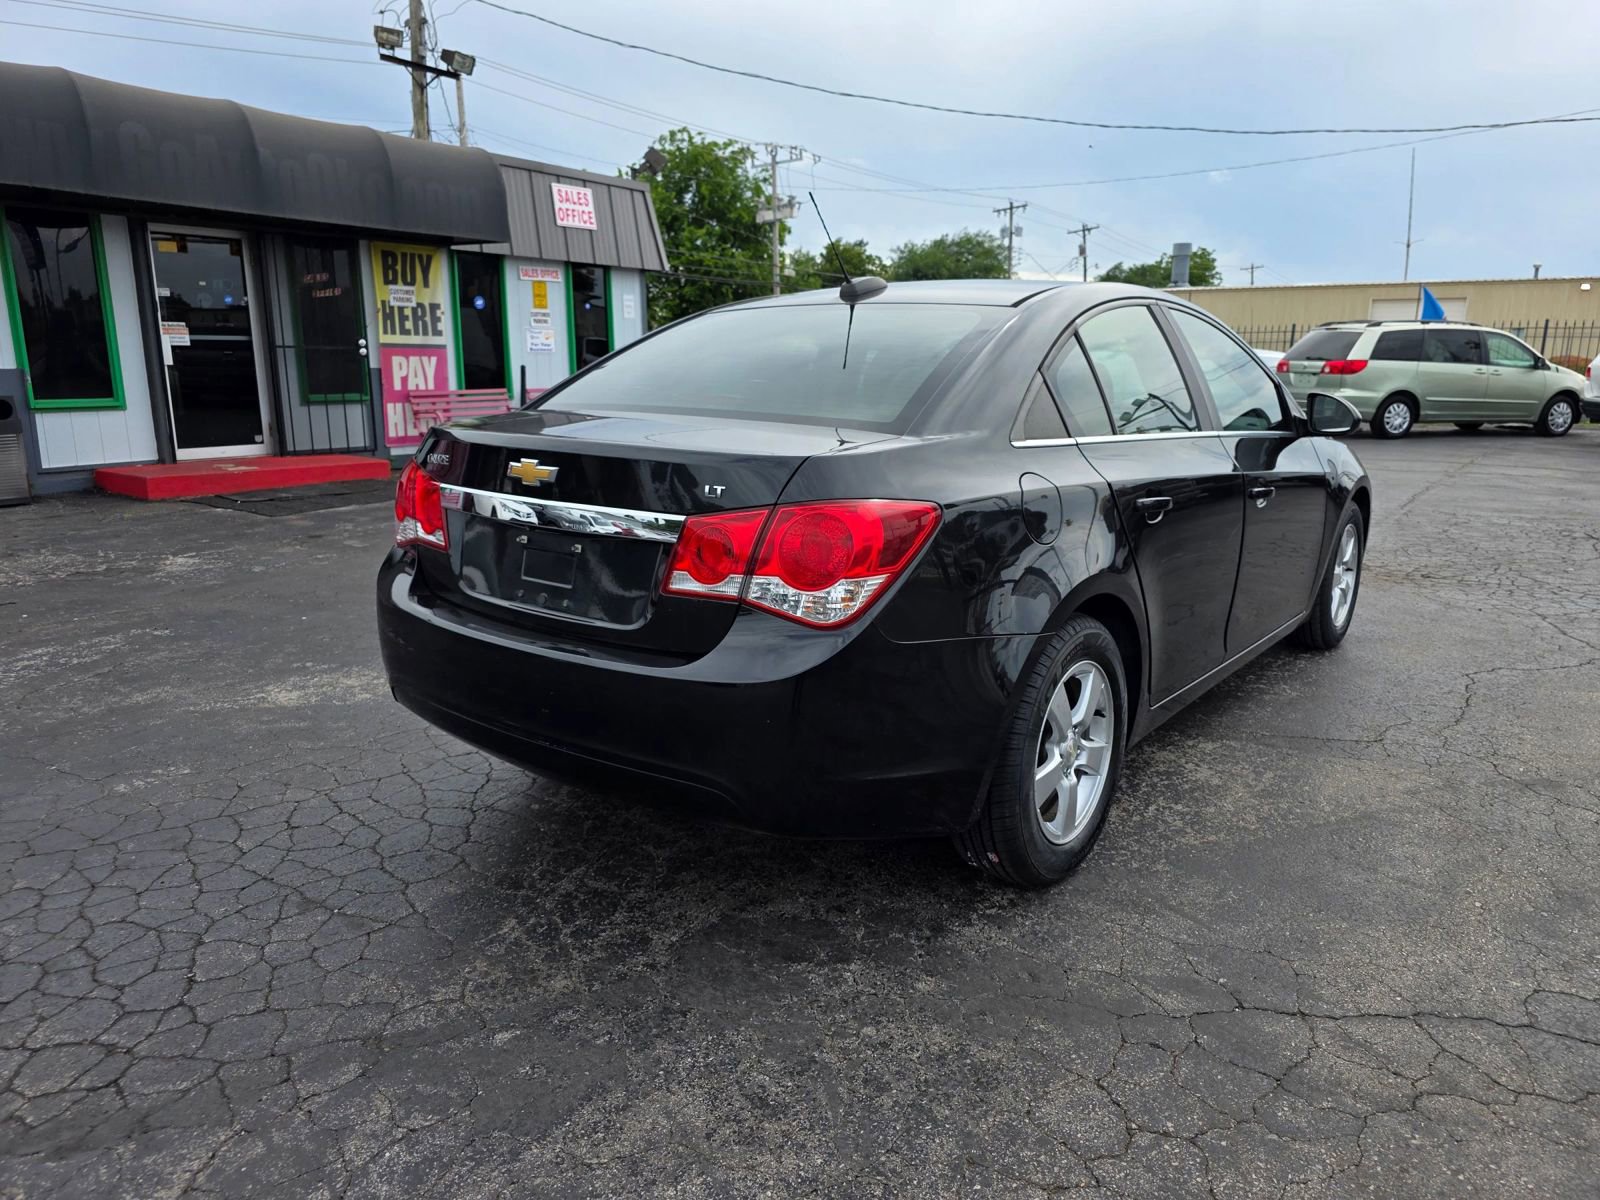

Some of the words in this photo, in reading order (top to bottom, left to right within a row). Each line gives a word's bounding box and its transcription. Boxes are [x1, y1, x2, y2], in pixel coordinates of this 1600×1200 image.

[557, 188, 590, 207] SALES
[558, 207, 595, 225] OFFICE
[381, 249, 433, 289] BUY
[520, 267, 539, 278] SALES
[540, 269, 560, 280] OFFICE
[390, 288, 415, 296] CUSTOMER
[381, 300, 443, 337] HERE
[391, 356, 438, 391] PAY
[704, 484, 727, 499] LT
